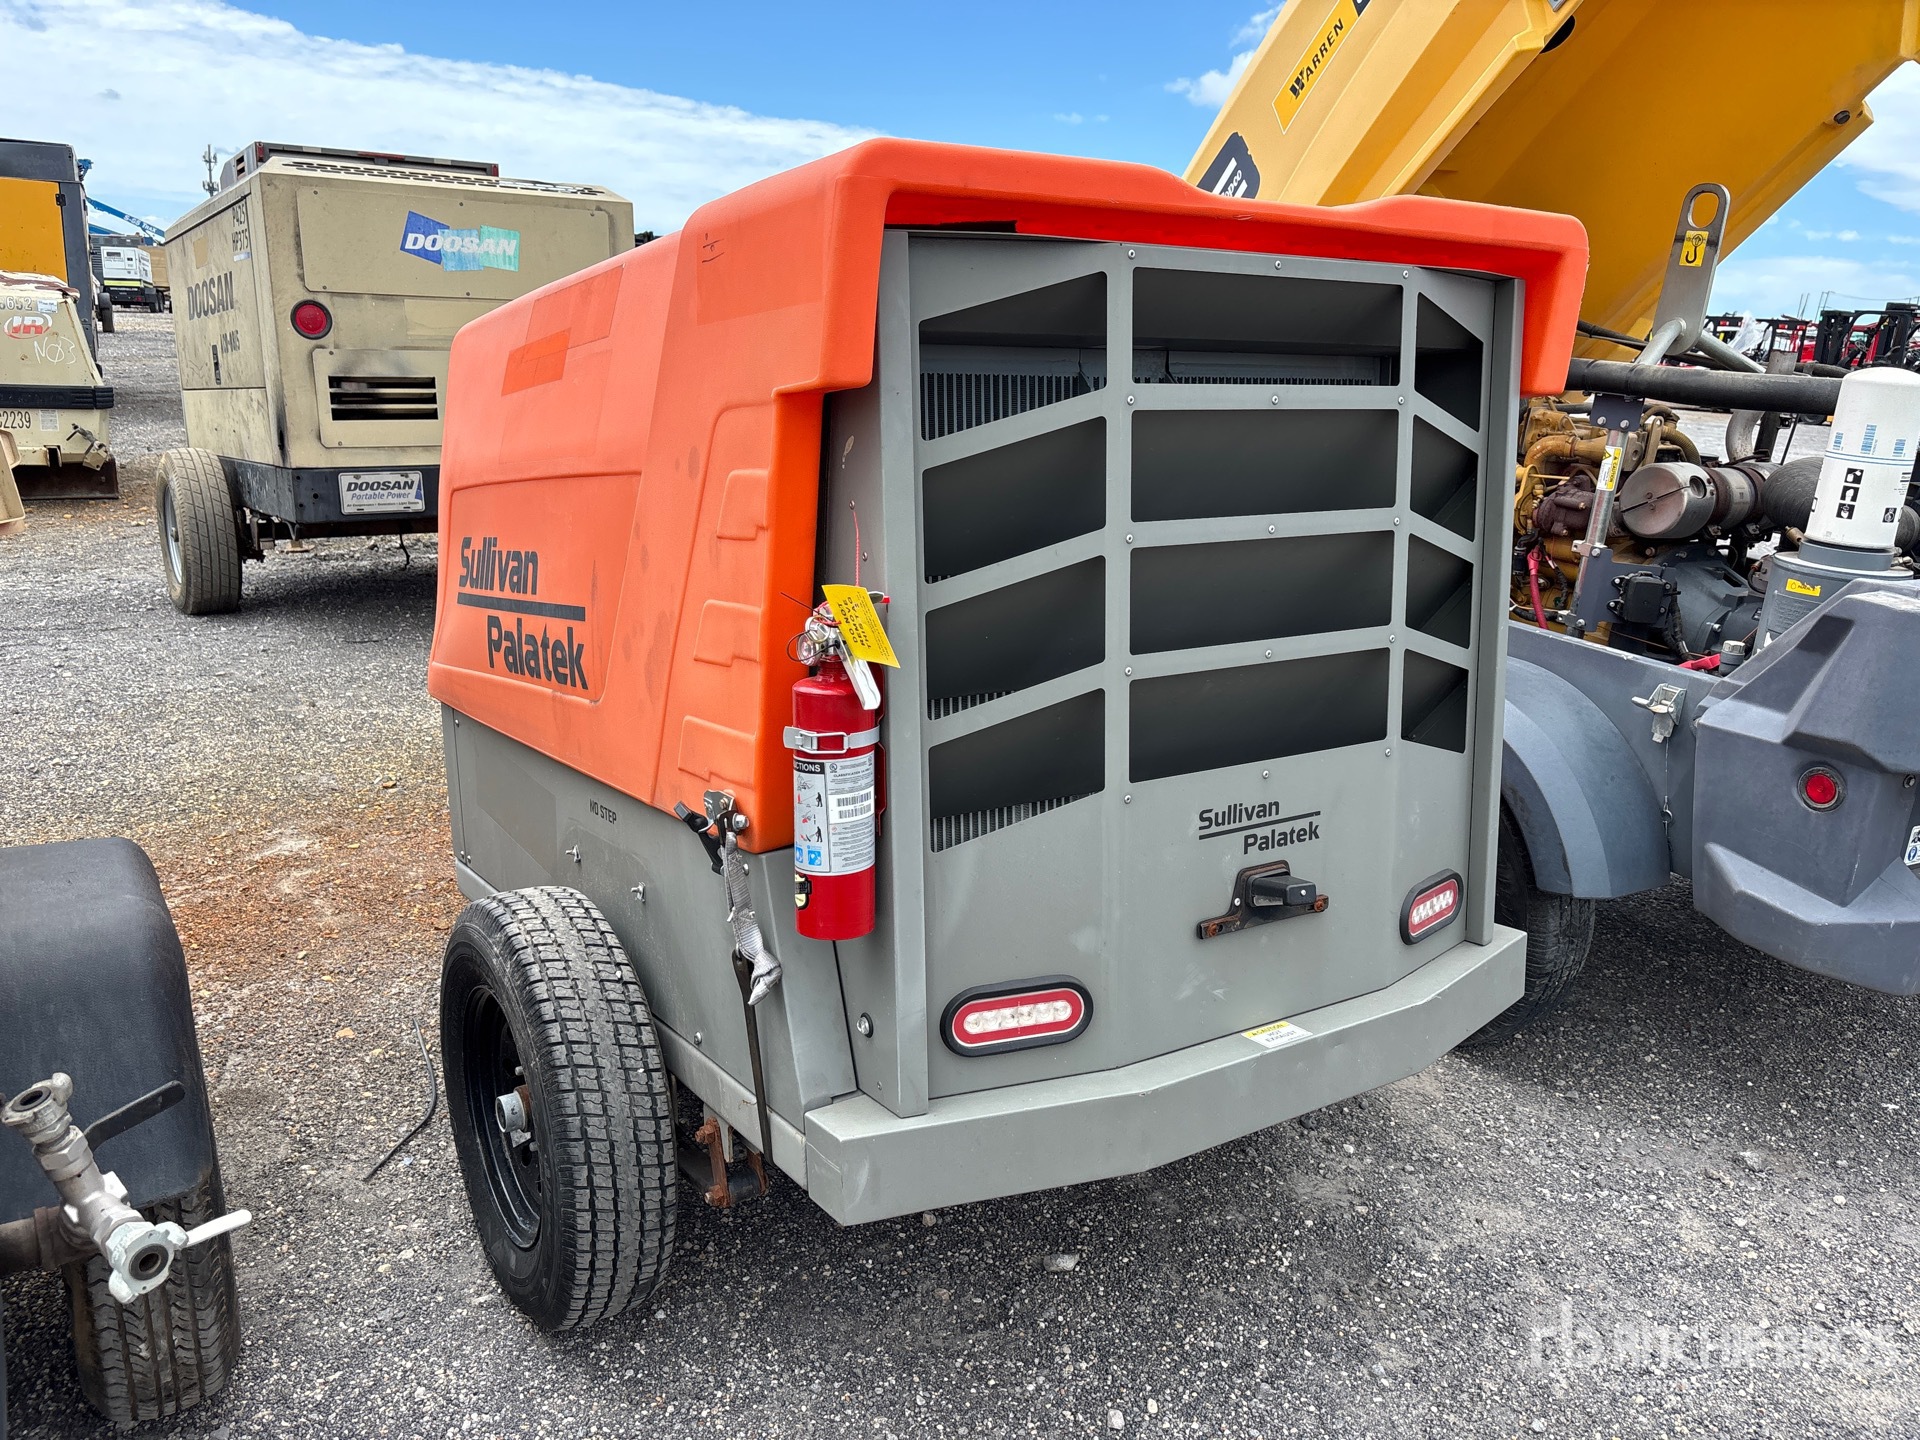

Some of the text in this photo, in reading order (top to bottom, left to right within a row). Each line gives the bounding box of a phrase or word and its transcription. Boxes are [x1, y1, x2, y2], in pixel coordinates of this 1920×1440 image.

[1288, 18, 1344, 100] WARREN
[404, 232, 517, 256] DOOSAN
[187, 270, 235, 321] DOOSAN
[0, 411, 31, 429] 2239
[346, 480, 415, 492] DOOSAN
[351, 490, 411, 500] Portable Power
[458, 536, 539, 596] Sullivan
[837, 602, 858, 643] DO NOT
[843, 599, 866, 646] REMOVE
[858, 623, 872, 649] THIS
[486, 614, 589, 690] Palatek
[589, 798, 617, 825] NO STEP
[1198, 800, 1280, 831] Sullivan
[1243, 821, 1320, 855] Palatek
[1256, 1023, 1284, 1035] CAUTION
